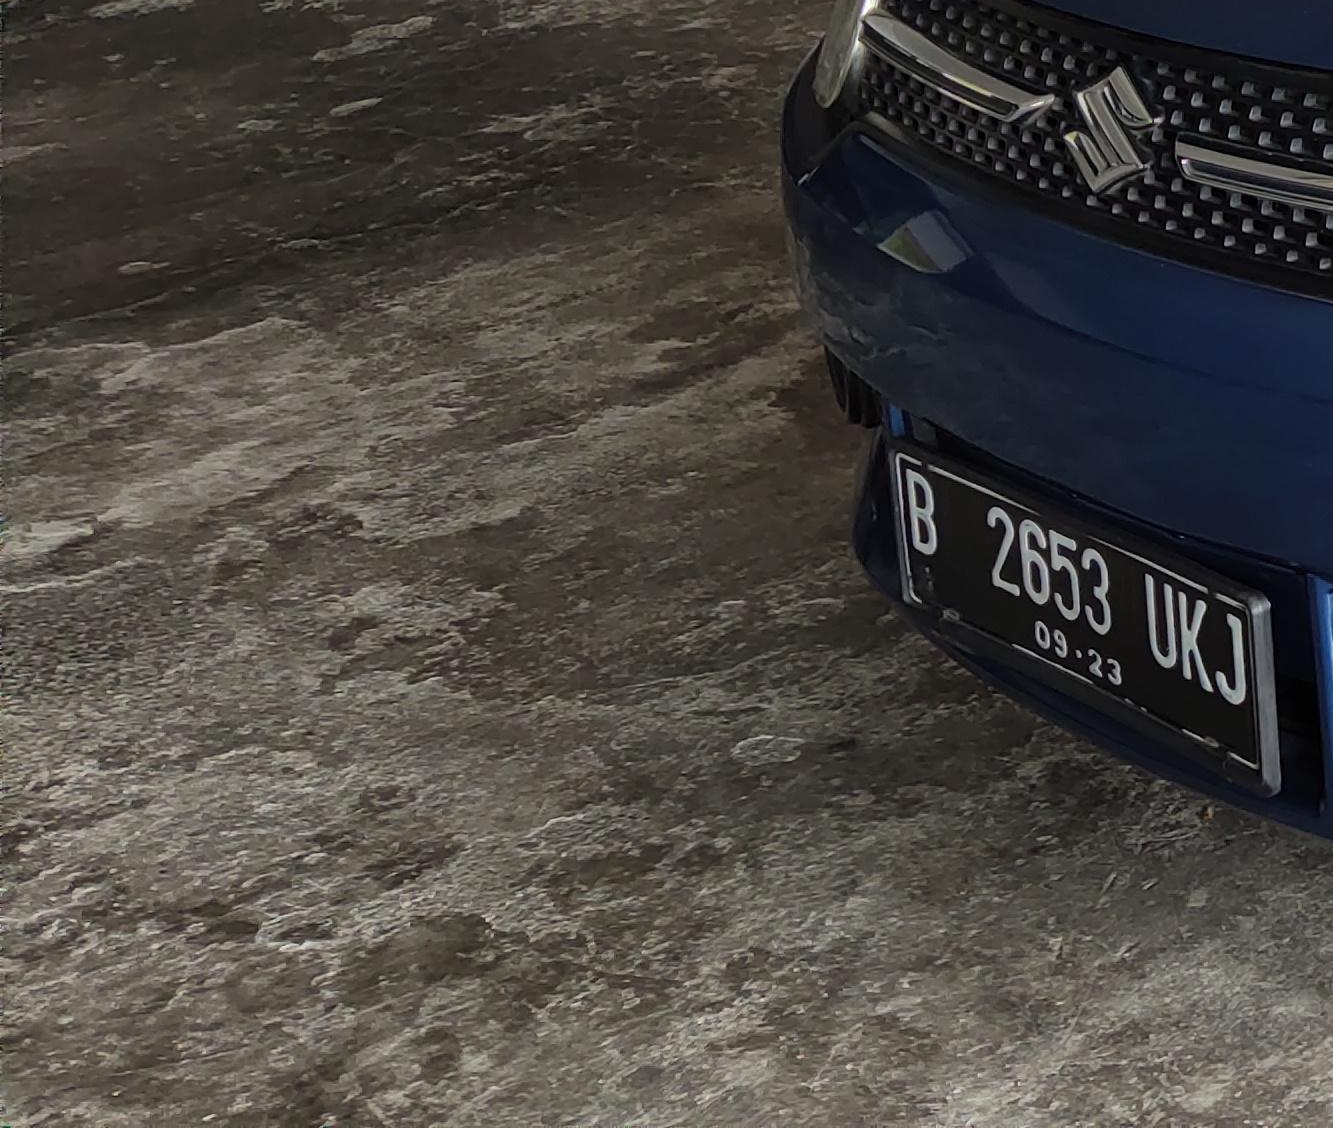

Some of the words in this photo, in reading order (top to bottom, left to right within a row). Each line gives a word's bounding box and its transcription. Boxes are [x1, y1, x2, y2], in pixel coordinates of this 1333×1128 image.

[906, 469, 937, 555] B
[987, 506, 1112, 635] 2653
[1145, 573, 1246, 705] UKJ
